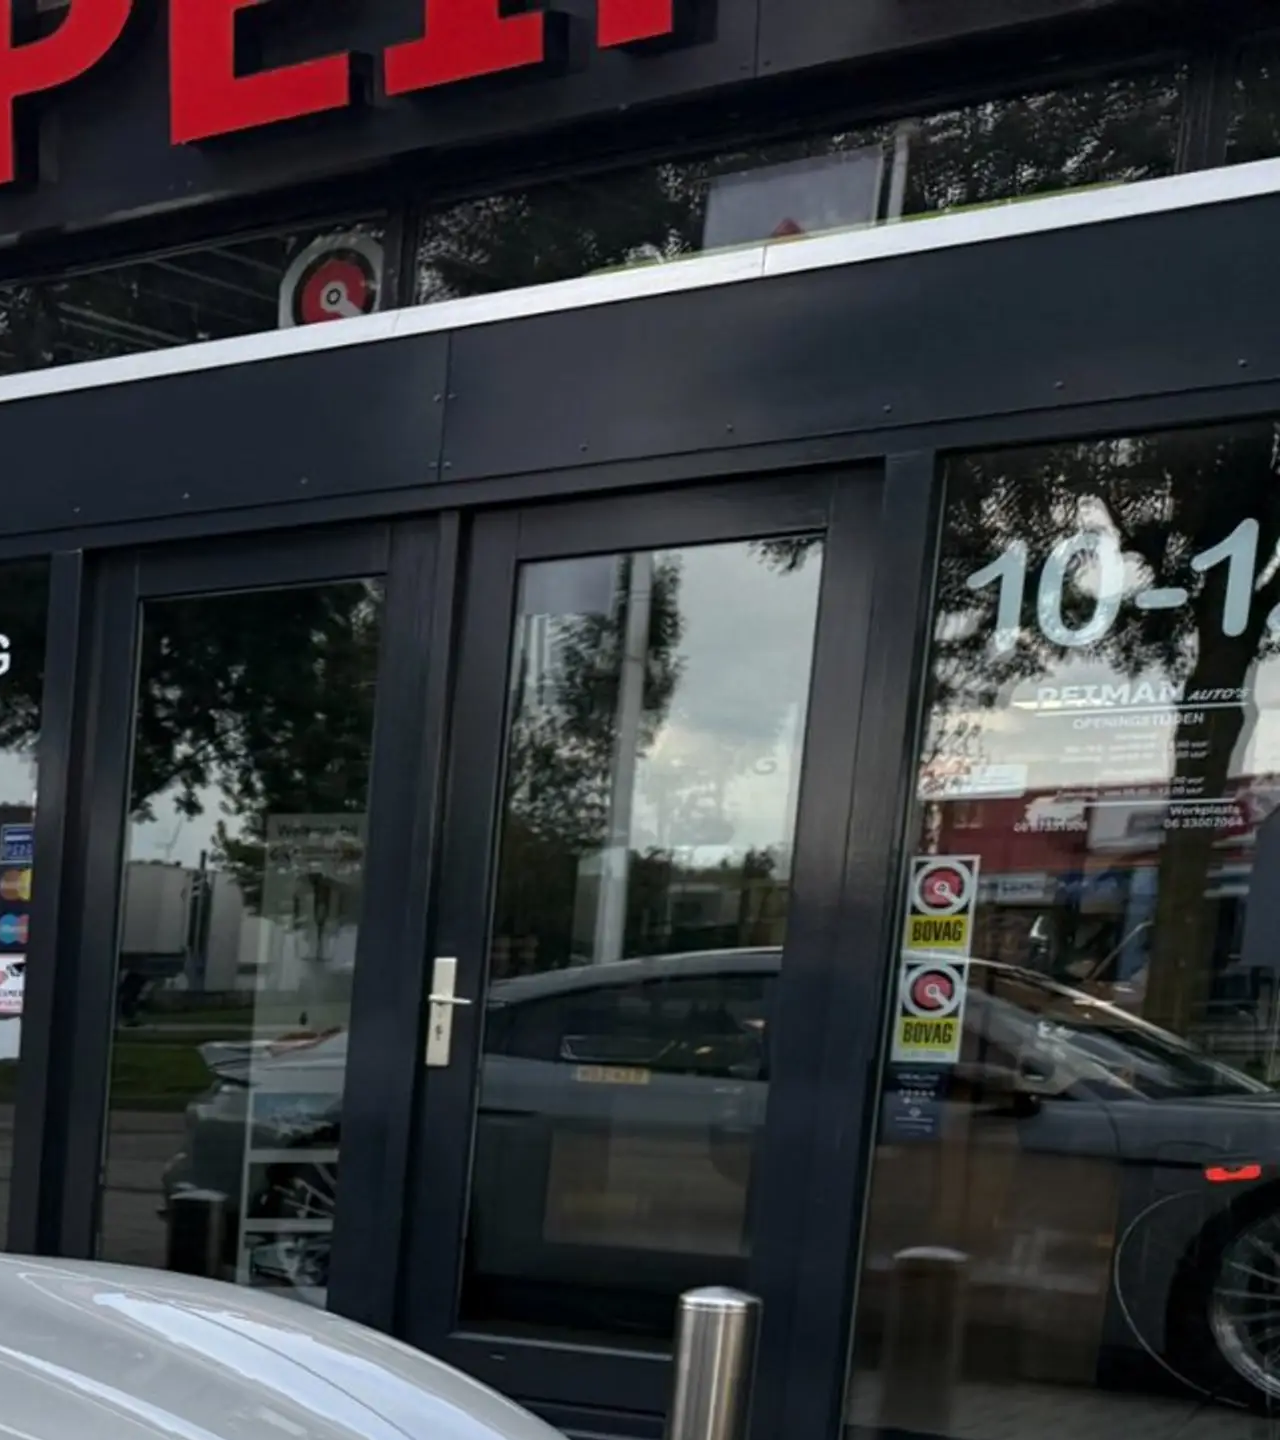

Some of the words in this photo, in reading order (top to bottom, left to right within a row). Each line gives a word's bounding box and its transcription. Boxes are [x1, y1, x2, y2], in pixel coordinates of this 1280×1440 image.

[966, 517, 1280, 648] 10-1
[912, 919, 964, 942] BOVAG
[902, 1020, 953, 1044] BOVAG
